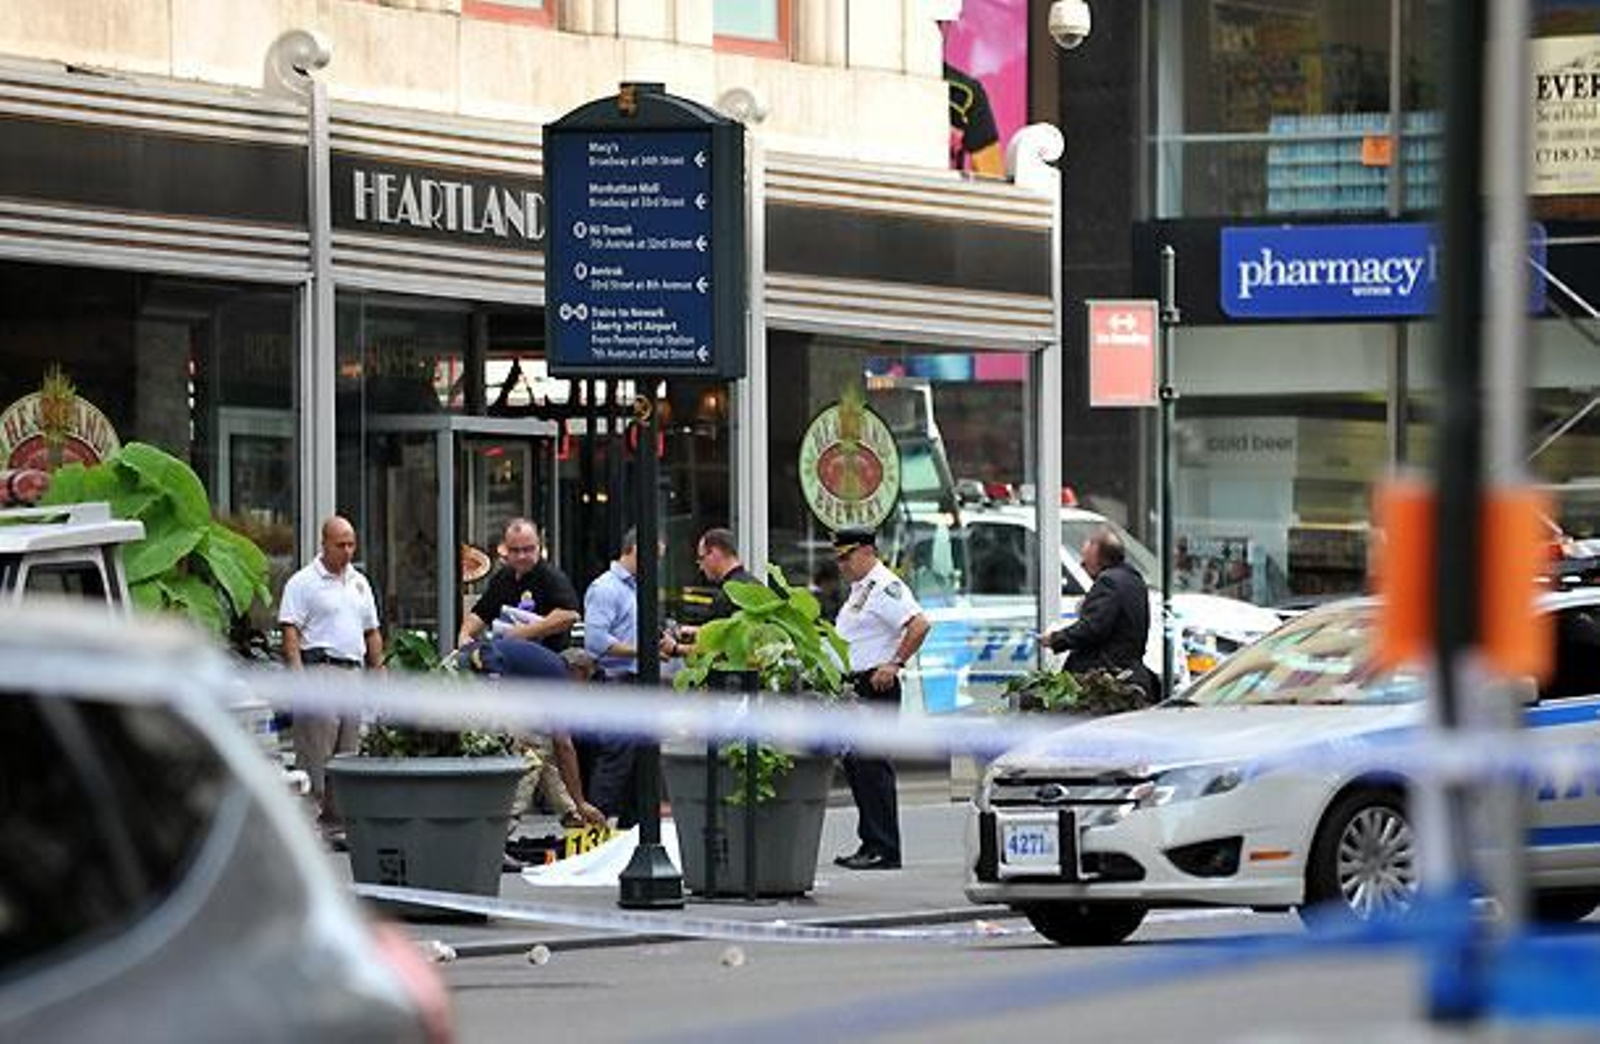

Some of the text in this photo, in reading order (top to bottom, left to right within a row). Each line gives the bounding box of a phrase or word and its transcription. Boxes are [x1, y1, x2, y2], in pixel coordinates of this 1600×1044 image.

[588, 156, 629, 168] Broadway
[630, 157, 640, 165] at
[660, 156, 685, 166] Street
[588, 183, 638, 195] Manhattan
[353, 170, 546, 240] HEARTLAND
[588, 197, 629, 209] Broadway
[630, 198, 640, 207] at
[661, 197, 685, 208] Street
[602, 225, 633, 236] Transit
[605, 238, 635, 249] Avenue
[636, 239, 646, 249] at
[669, 238, 693, 249] Street
[590, 267, 623, 277] Amtrak
[1238, 248, 1424, 299] pharmacy
[610, 280, 635, 291] Street
[636, 281, 645, 290] at
[662, 280, 693, 291] Avenue
[591, 307, 617, 318] Trains
[630, 307, 664, 318] Newark
[591, 321, 622, 333] Liberty
[644, 321, 677, 333] Airport
[613, 335, 664, 347] Pennsylvania
[665, 335, 695, 346] Station
[607, 349, 637, 359] Avenue
[638, 350, 648, 359] at
[670, 348, 695, 359] Street
[1206, 433, 1293, 451] cold beer
